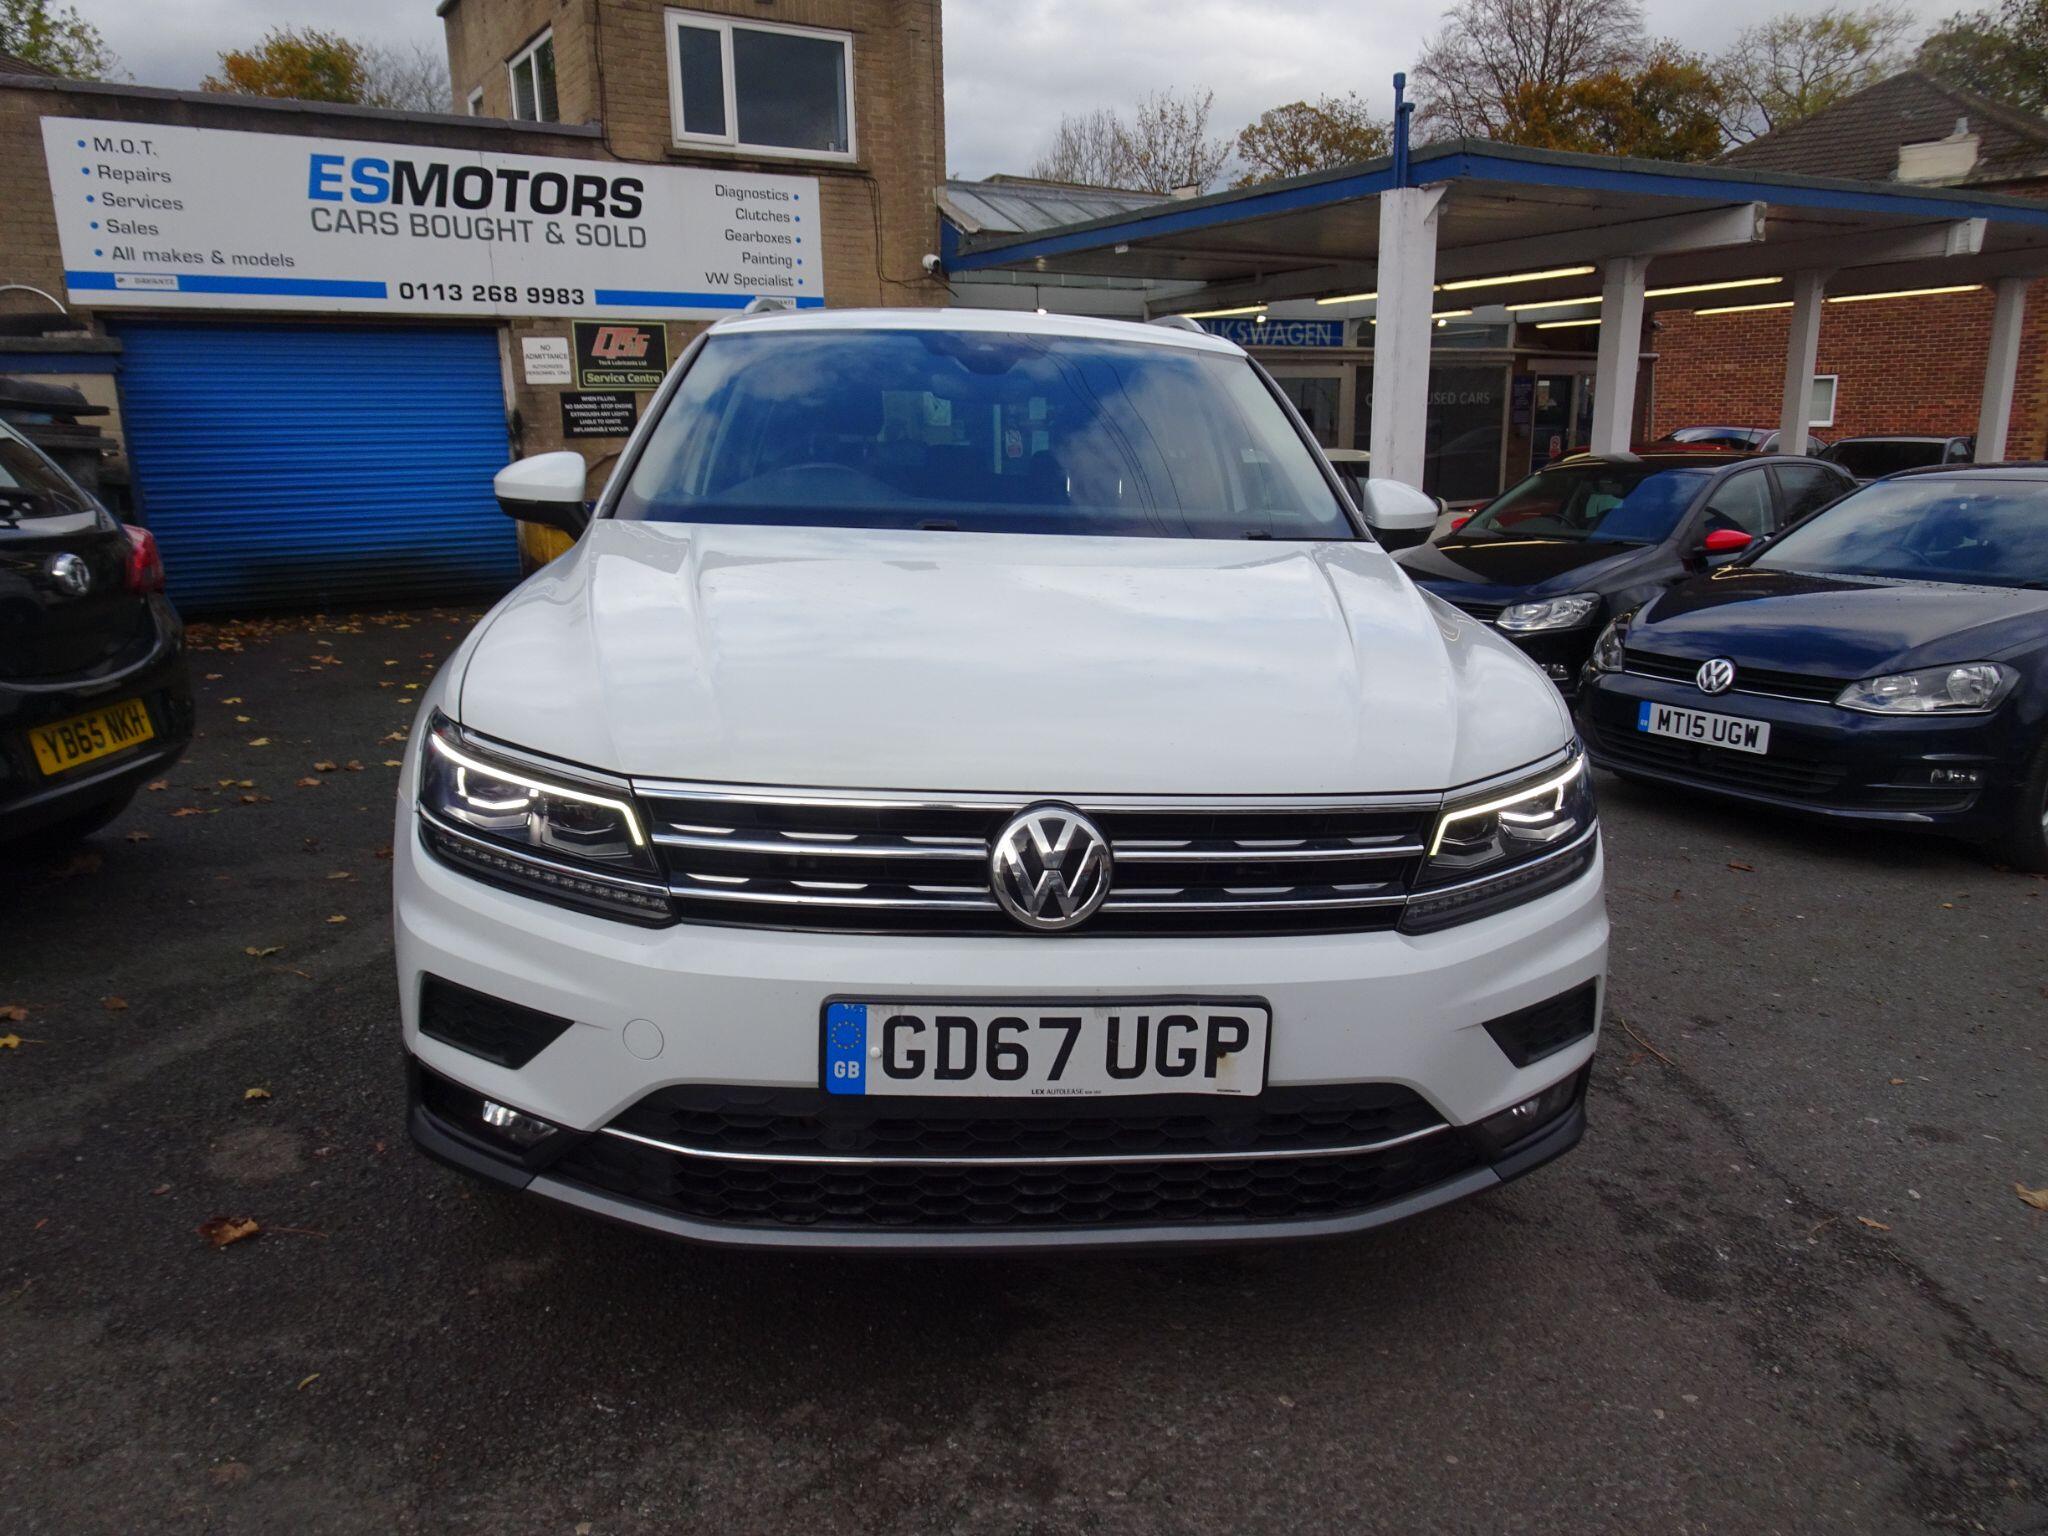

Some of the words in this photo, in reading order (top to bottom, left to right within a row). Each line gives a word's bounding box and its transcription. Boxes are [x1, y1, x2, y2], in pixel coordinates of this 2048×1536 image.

[93, 137, 159, 157] M.O.T.
[97, 164, 172, 184] Repairs
[102, 192, 184, 210] Services
[715, 184, 789, 201] Diagnostics
[735, 207, 790, 223] Clutches
[106, 218, 160, 236] Sales
[311, 207, 399, 236] CARS
[409, 213, 533, 243] BOUGHT
[545, 221, 565, 244] &
[576, 223, 646, 248] SOLD
[724, 228, 792, 244] Gearboxes
[112, 246, 136, 261] All
[143, 248, 204, 264] makes
[210, 250, 225, 264] &
[232, 253, 295, 267] models
[742, 251, 793, 269] Painting
[705, 272, 729, 284] VW
[733, 273, 794, 288] Specialist
[399, 282, 463, 301] 0113
[472, 285, 518, 302] 268
[526, 287, 585, 305] 9983
[586, 372, 625, 383] Service
[627, 373, 660, 384] Centre
[1459, 391, 1491, 405] CARS
[42, 715, 107, 764] YB65
[104, 704, 146, 745] NKH
[1657, 708, 1707, 739] MT15
[1712, 718, 1760, 749] UGW
[882, 1014, 1083, 1081] GD67
[1105, 1014, 1249, 1079] UGP
[834, 1060, 860, 1079] GB
